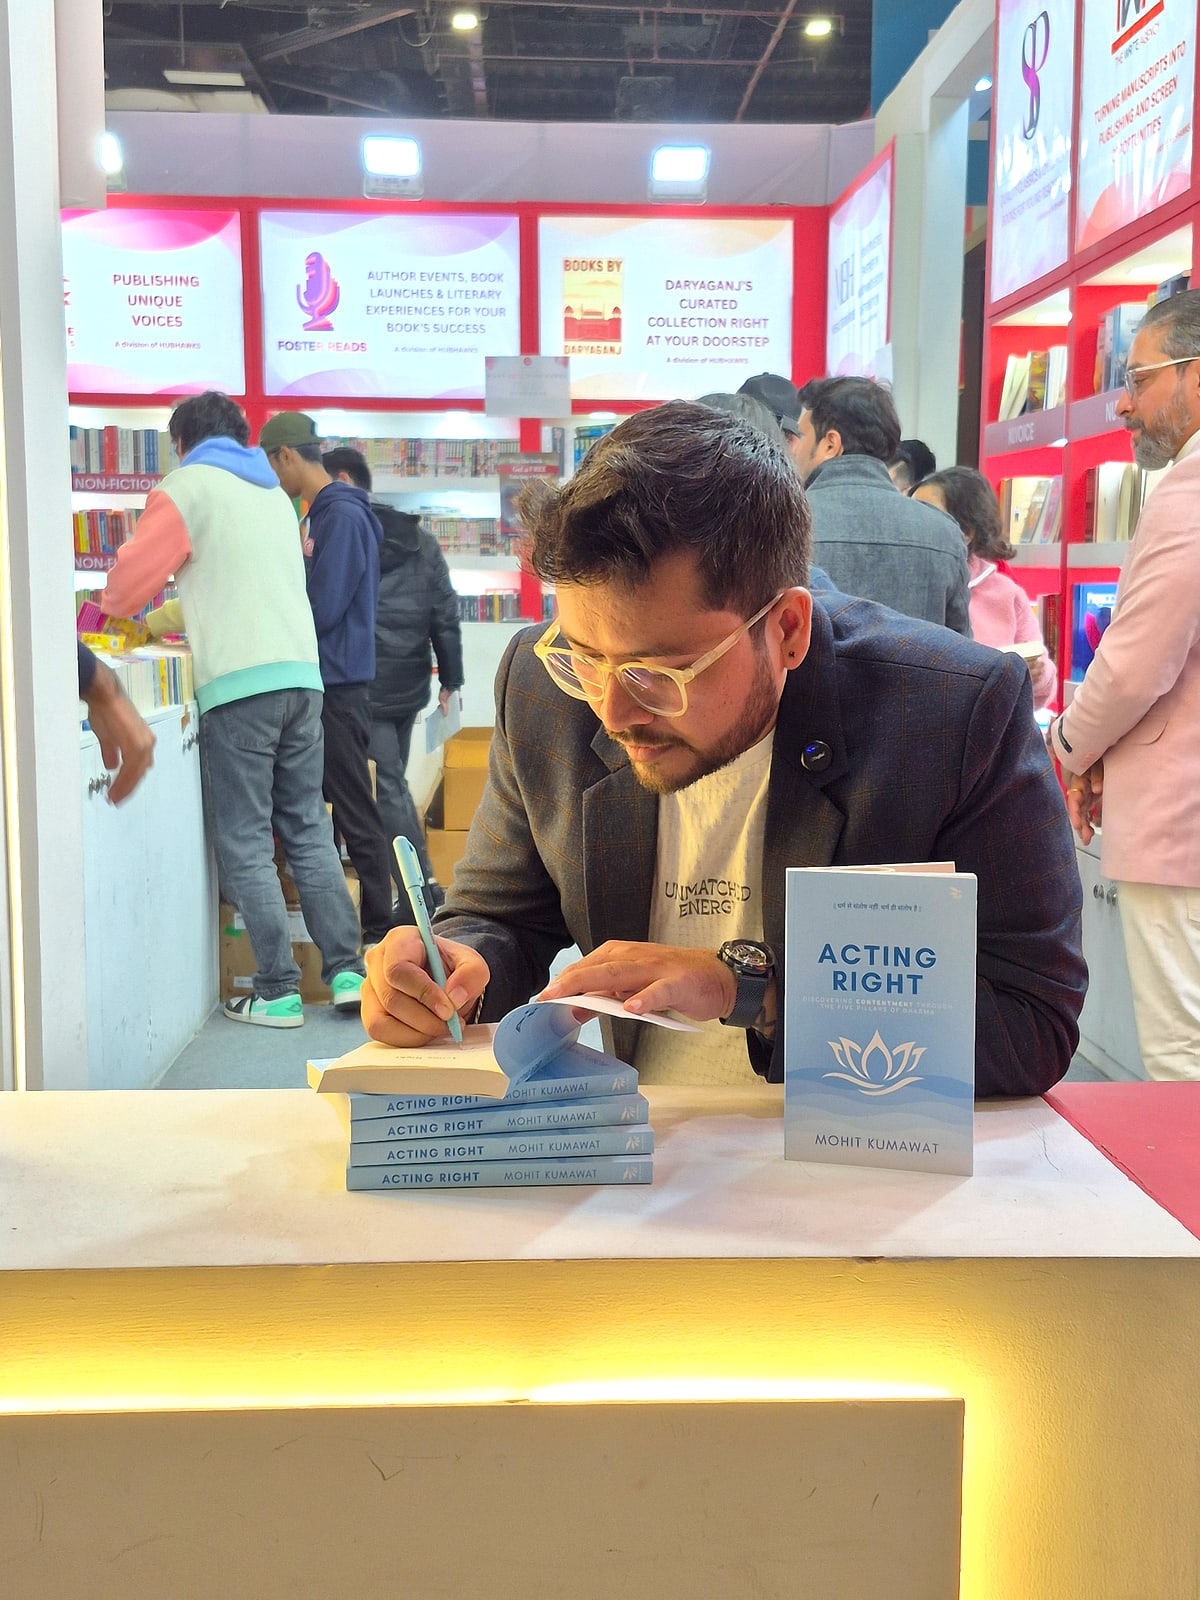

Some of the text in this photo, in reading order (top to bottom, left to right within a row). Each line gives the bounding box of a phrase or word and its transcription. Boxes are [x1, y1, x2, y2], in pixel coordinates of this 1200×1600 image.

[1094, 40, 1185, 124] TURNING MANUSCRIPTS INTO
[1099, 108, 1135, 145] PUBLISHING
[1136, 96, 1150, 118] AND
[1151, 74, 1178, 107] SCREEN
[564, 260, 622, 272] BOOKS BY
[113, 274, 200, 287] PUBLISHING
[367, 271, 504, 283] AUTHOR EVENTS, BOOK
[370, 288, 502, 300] LAUNCHES & LITERARY
[127, 295, 183, 309] UNIQUE
[679, 299, 738, 310] CURATED
[366, 305, 506, 318] EXPERIENCES FOR YOUR
[132, 315, 183, 328] VOICES
[386, 322, 486, 334] BOOK'S SUCCESS
[647, 317, 769, 329] COLLECTION RIGHT
[277, 340, 367, 352] FOSTER READS
[646, 335, 770, 347] AT YOUR DOORSTEP
[564, 344, 622, 355] DARYAGANJ
[75, 478, 160, 491] NON-FICTION
[75, 556, 117, 569] NON-F
[818, 943, 937, 969] ACTING
[833, 970, 923, 995] RIGHT
[856, 999, 913, 1008] CONTENTMENT
[387, 1098, 437, 1112] ACTING
[541, 1082, 588, 1096] KUMAWAT
[388, 1111, 598, 1136] ACTING RIGHT MOHIT KUMAWAT
[387, 1140, 601, 1160] ACTING RIGHT MOHIT KUMAWAT
[815, 1134, 940, 1154] MOHIT KUMAWAT
[382, 1169, 598, 1184] ACTING RIGHT MOHIT KUMAWAT
